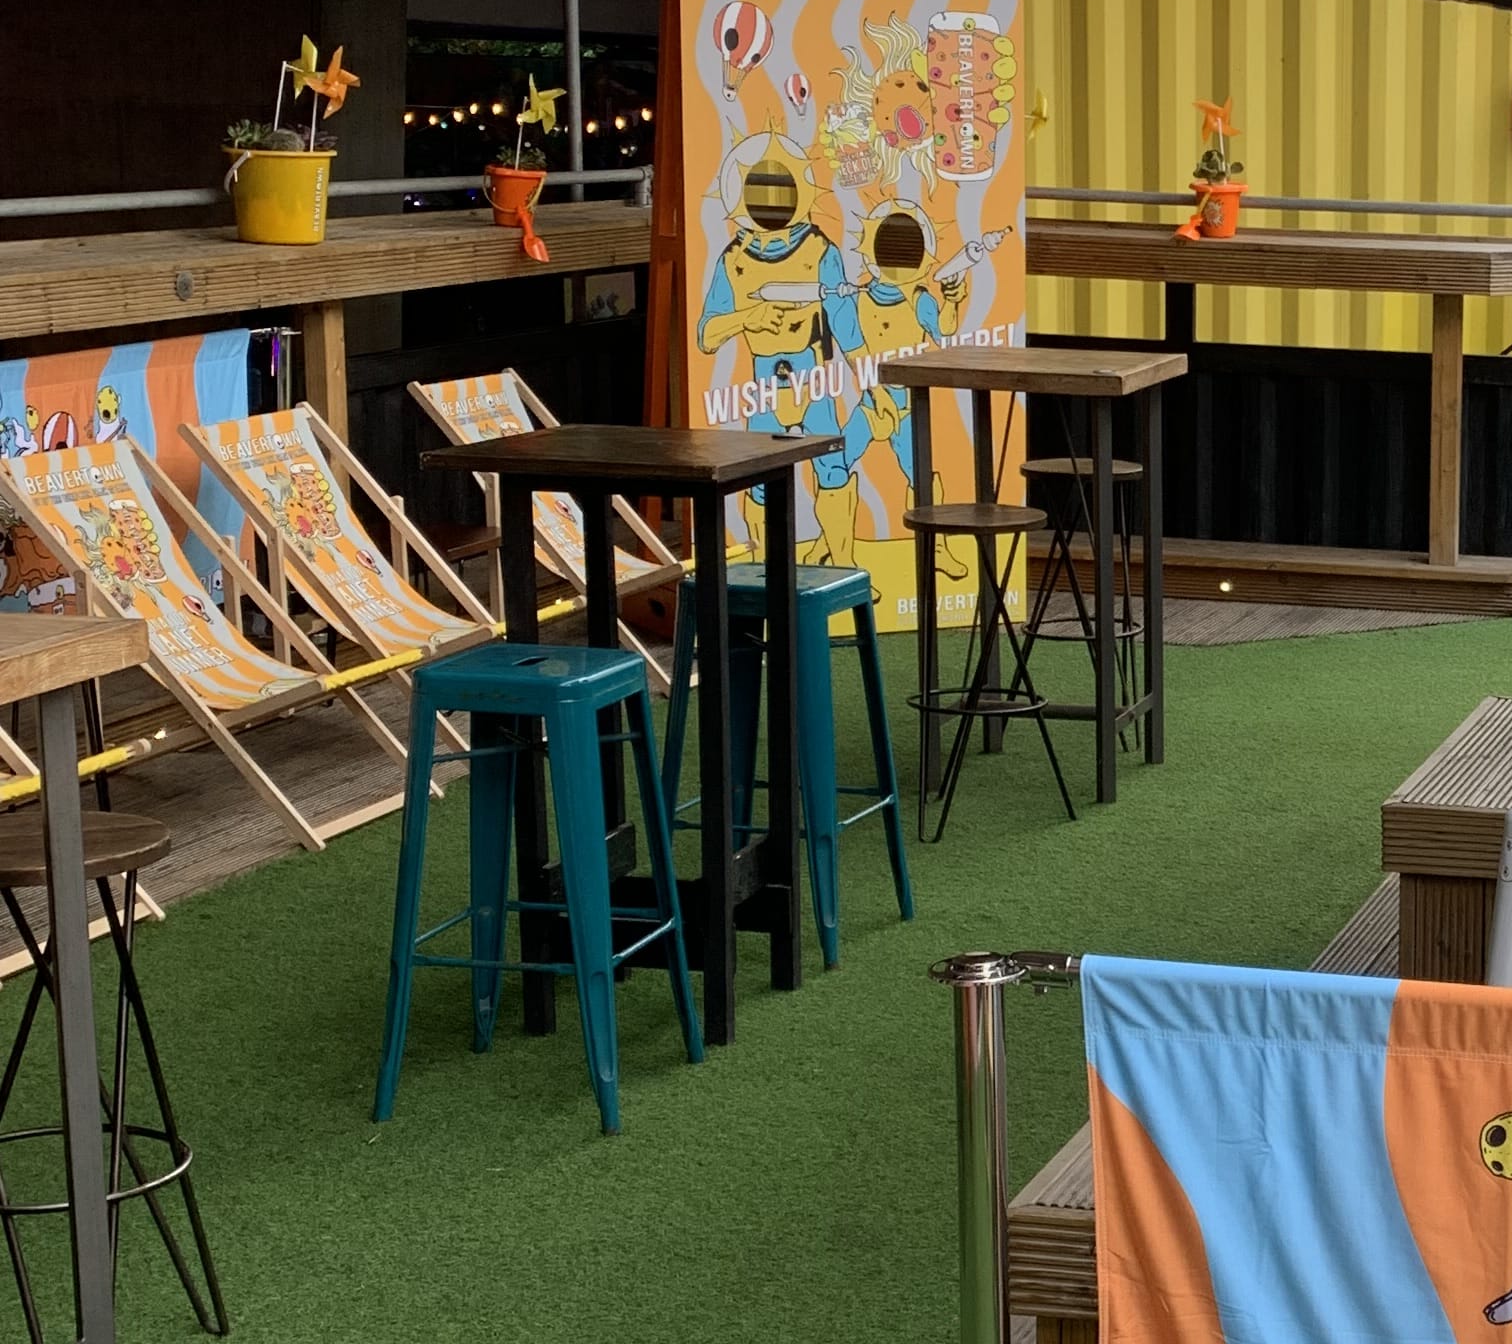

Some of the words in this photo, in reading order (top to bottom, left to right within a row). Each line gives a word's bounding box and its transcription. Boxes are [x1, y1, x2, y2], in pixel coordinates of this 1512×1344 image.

[958, 33, 975, 169] BEAVERTOWN
[703, 376, 777, 425] WISH
[789, 361, 845, 407] YOU
[219, 428, 304, 462] BEAVERTOWN
[24, 461, 125, 494] BEAVERTOWN
